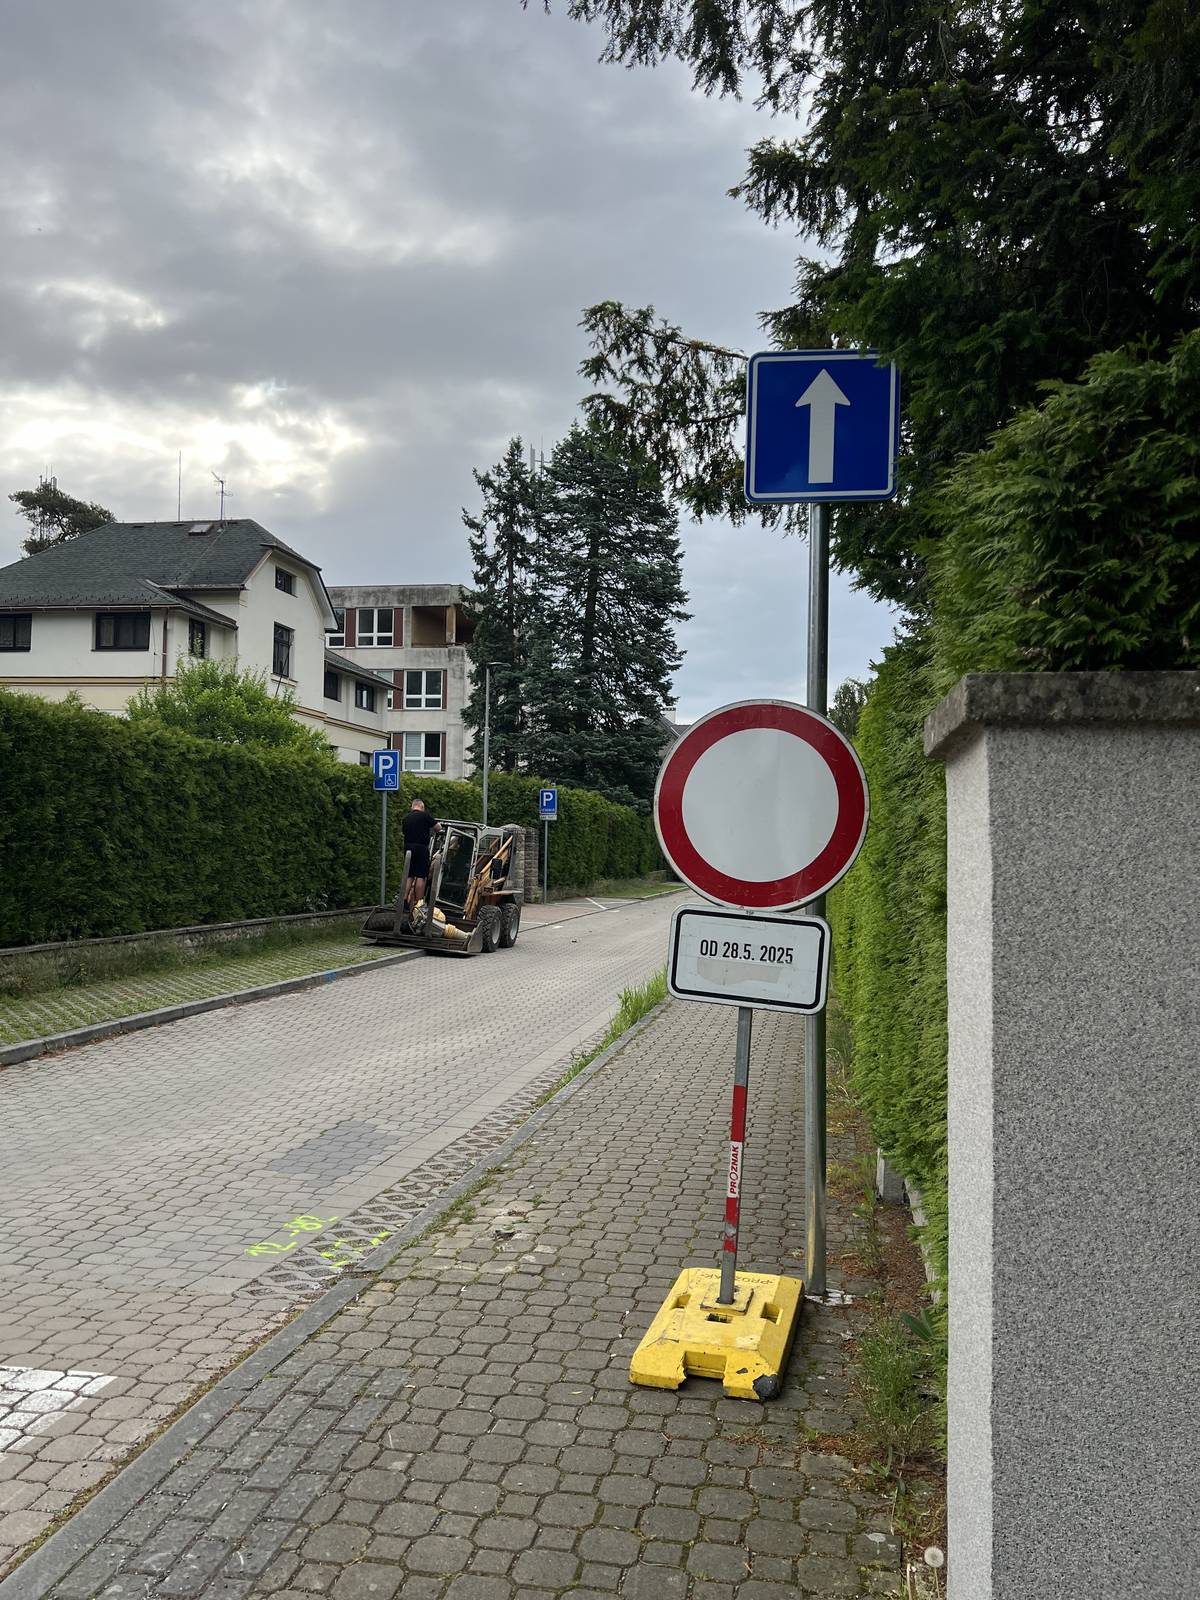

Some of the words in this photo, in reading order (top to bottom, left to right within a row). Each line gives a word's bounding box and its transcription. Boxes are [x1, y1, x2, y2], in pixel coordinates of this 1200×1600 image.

[378, 755, 394, 778] P
[543, 792, 553, 806] P
[700, 939, 718, 957] OD
[722, 941, 755, 961] 28.5.
[760, 945, 794, 964] 2025
[729, 1145, 739, 1195] PROZNAK
[705, 1274, 770, 1284] PROZAK
